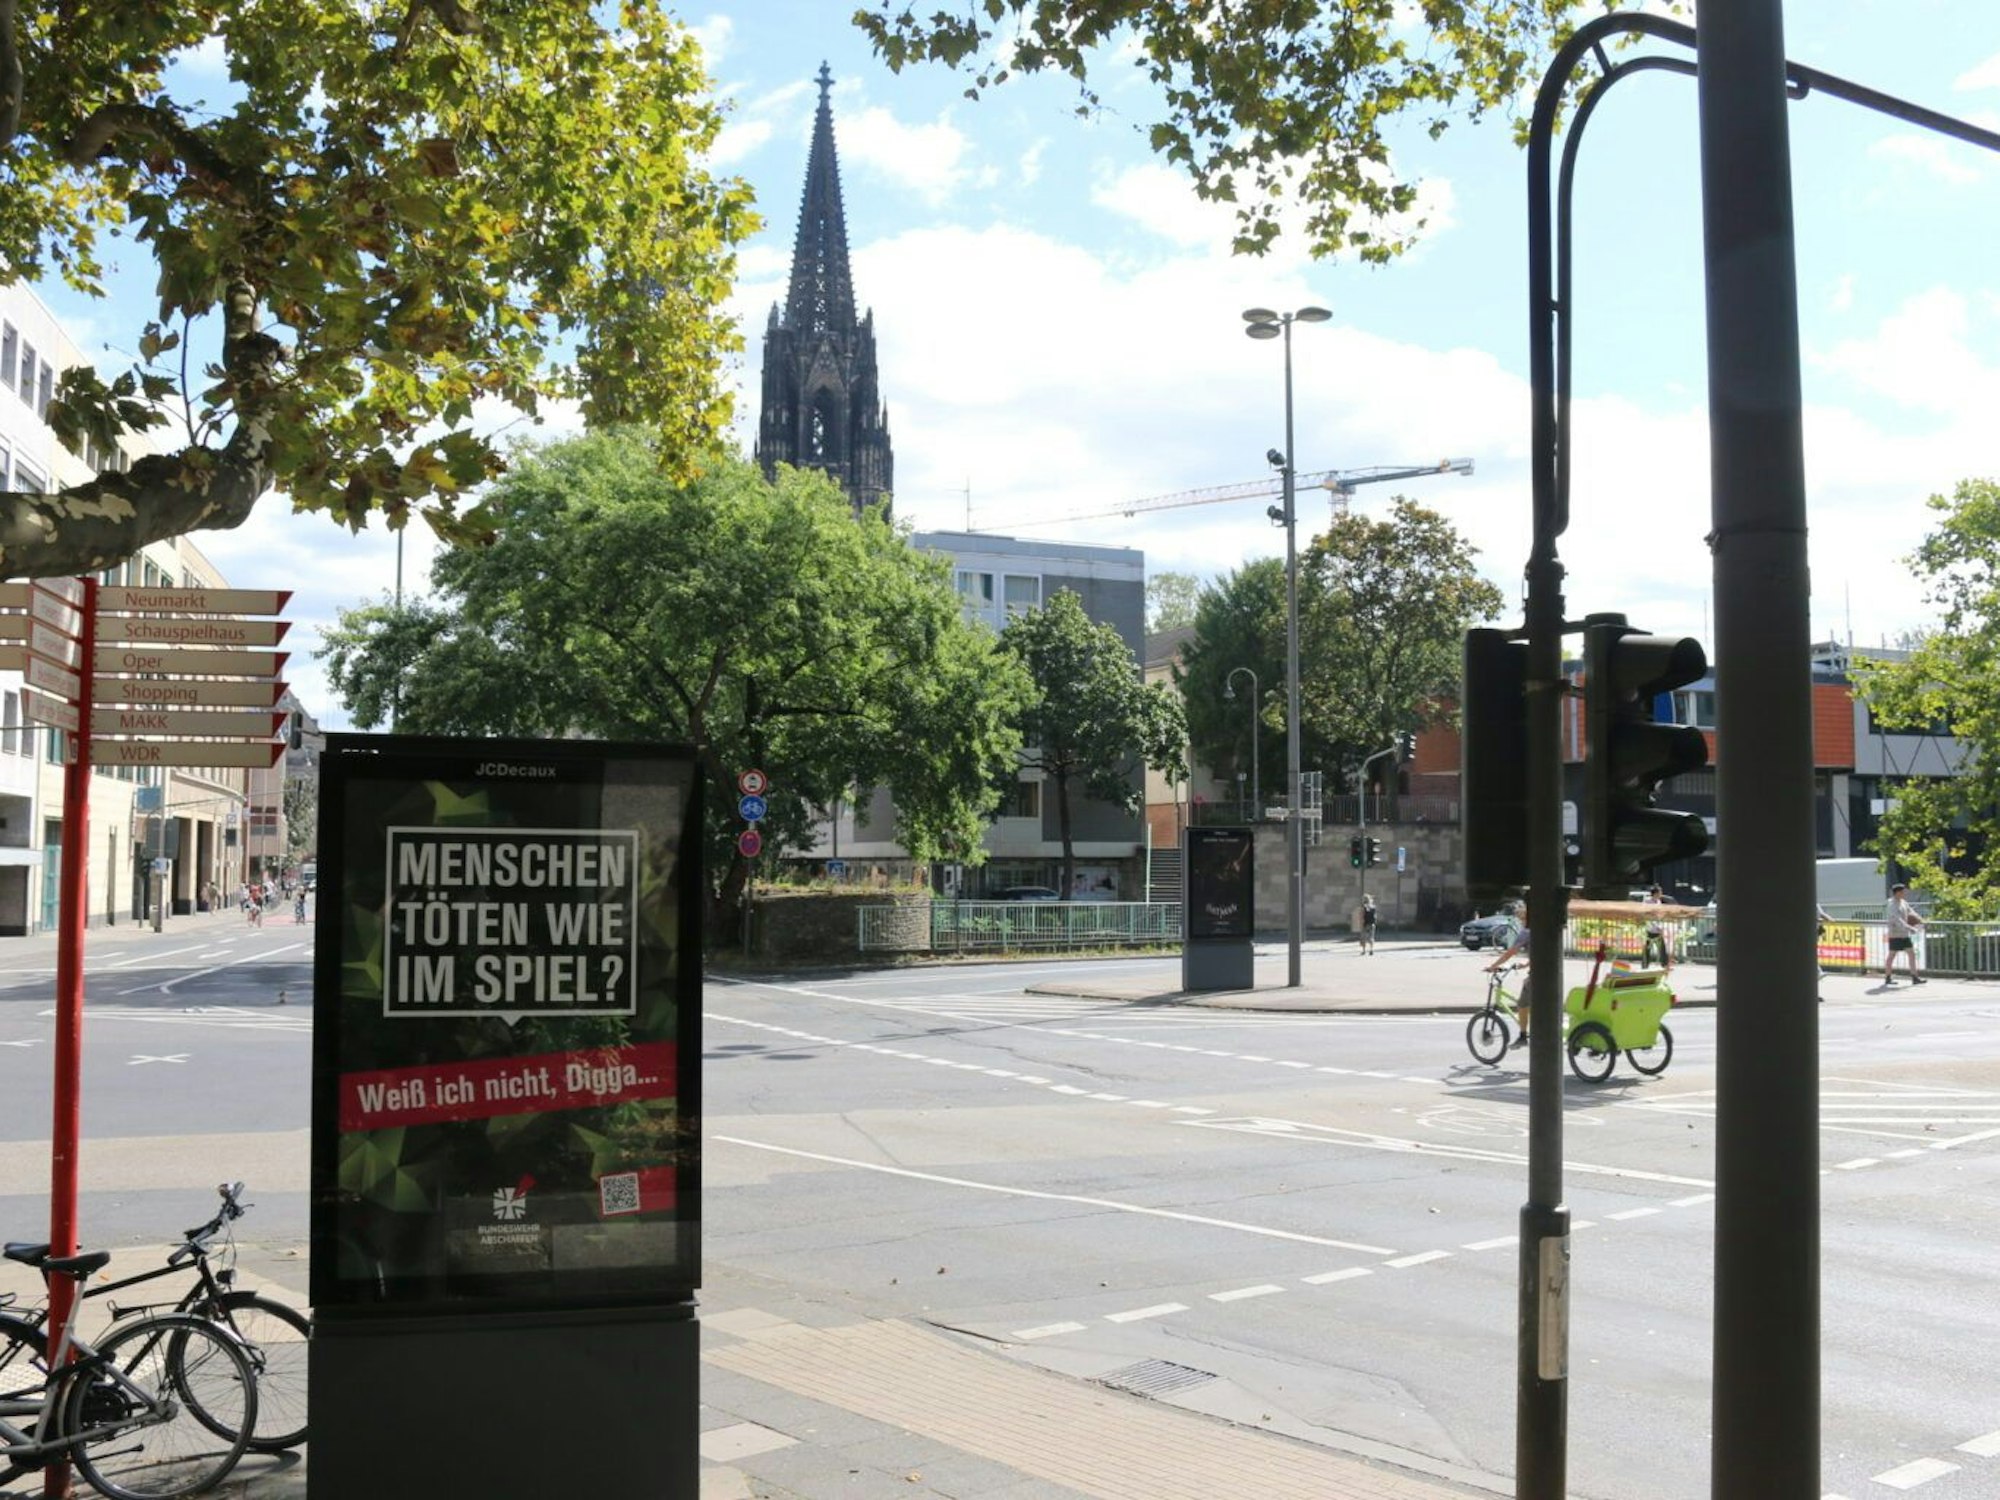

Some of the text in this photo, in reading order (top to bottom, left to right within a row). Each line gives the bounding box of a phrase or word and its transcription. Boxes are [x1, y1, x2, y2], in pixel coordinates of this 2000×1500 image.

[125, 592, 206, 607] Neumarkt
[125, 623, 245, 641] Schauspielhaus
[123, 654, 163, 672] Oper
[122, 684, 198, 703] Shopping
[120, 714, 168, 729] MAKK
[120, 746, 160, 761] WDR
[475, 763, 556, 777] JCDecaux
[399, 843, 625, 887] MENSCHEN
[398, 892, 624, 946] TÖTEN WIE
[399, 955, 624, 1003] IM SPIEL?
[357, 1062, 659, 1113] Weiß ich nicht, Digga...
[478, 1224, 540, 1234] BUNDESWEHR
